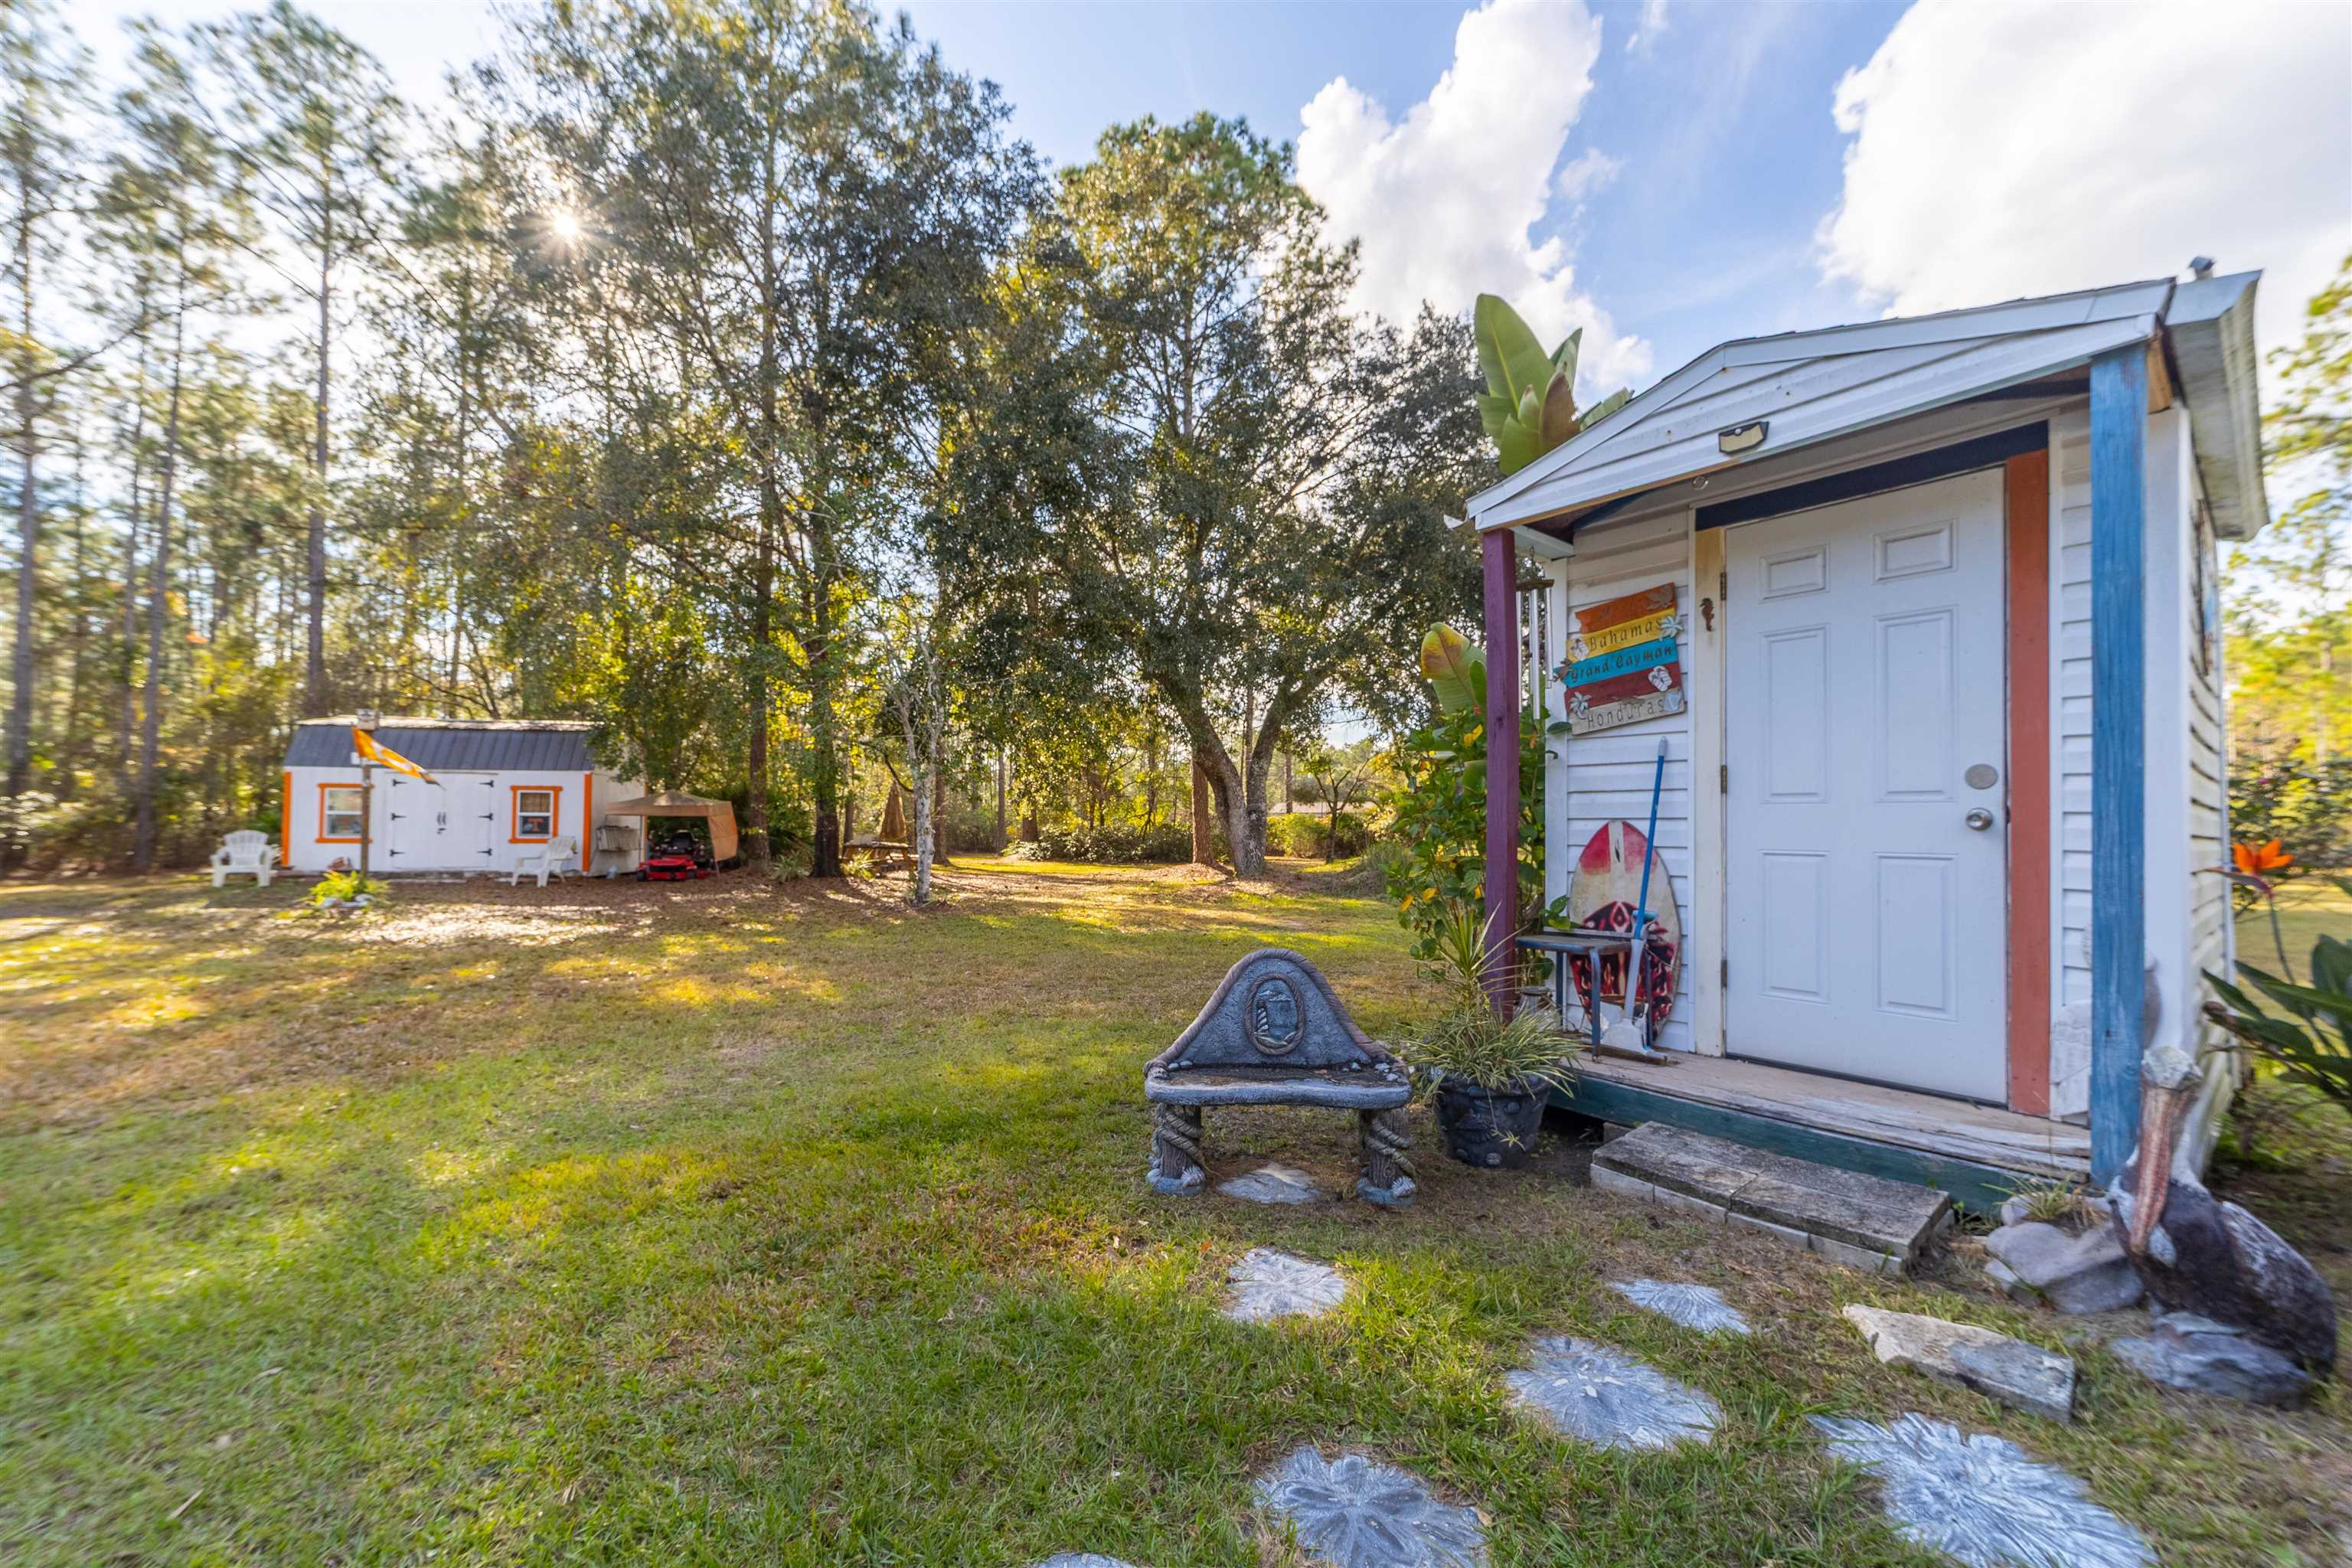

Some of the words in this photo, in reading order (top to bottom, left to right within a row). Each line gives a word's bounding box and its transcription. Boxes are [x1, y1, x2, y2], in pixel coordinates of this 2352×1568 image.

[1587, 619, 1663, 652] Bahamas
[1570, 659, 1610, 683] Grand
[1615, 646, 1673, 669] Cayman
[1586, 699, 1664, 729] Honduras
